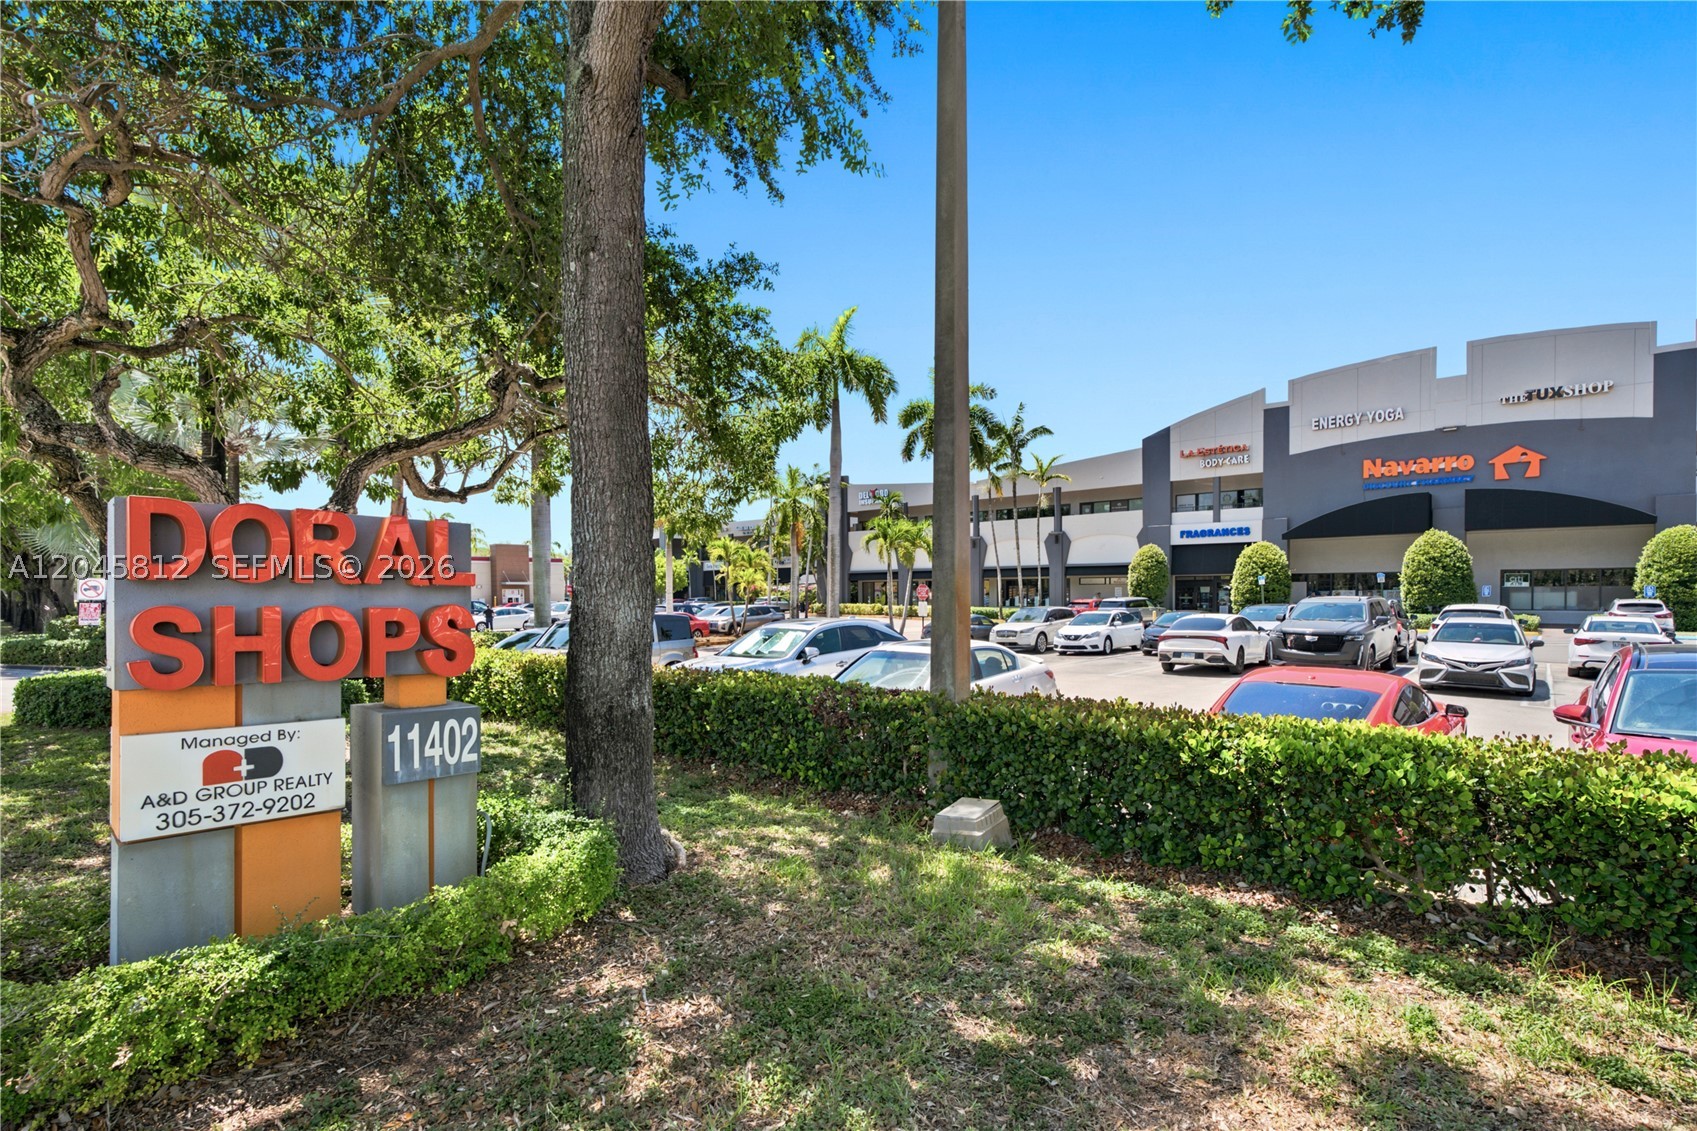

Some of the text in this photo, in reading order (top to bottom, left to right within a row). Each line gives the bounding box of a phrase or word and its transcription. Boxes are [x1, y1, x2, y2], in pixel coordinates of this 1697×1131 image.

[1525, 386, 1563, 401] TUX
[1563, 380, 1615, 398] SHOP
[1311, 407, 1405, 431] ENERGY YOGA
[1200, 454, 1250, 469] BODY CARE
[1362, 454, 1475, 479] Navarro
[126, 495, 476, 587] DORAL
[1180, 526, 1251, 539] FRAGRANCES
[126, 604, 476, 691] SHOPS
[181, 729, 301, 750] Managed By:
[388, 717, 478, 772] 11402
[140, 772, 333, 810] A&D GROUP REALTY
[156, 792, 316, 831] 305-372-9202
